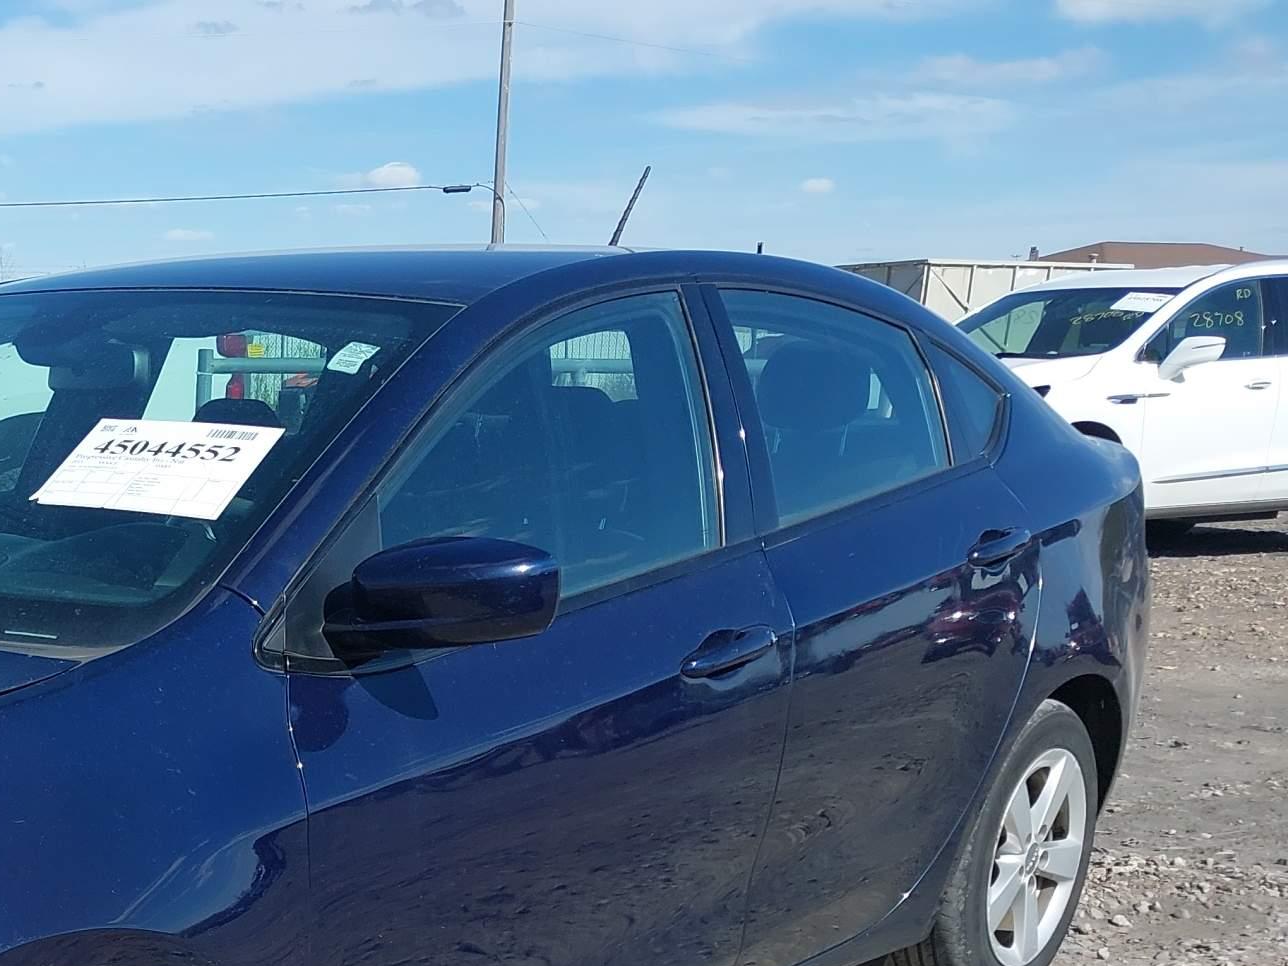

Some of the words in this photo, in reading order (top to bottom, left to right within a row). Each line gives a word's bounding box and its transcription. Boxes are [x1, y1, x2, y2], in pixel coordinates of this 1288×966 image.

[1236, 288, 1252, 300] RD
[1190, 311, 1245, 328] 28708
[94, 438, 242, 463] 45044552
